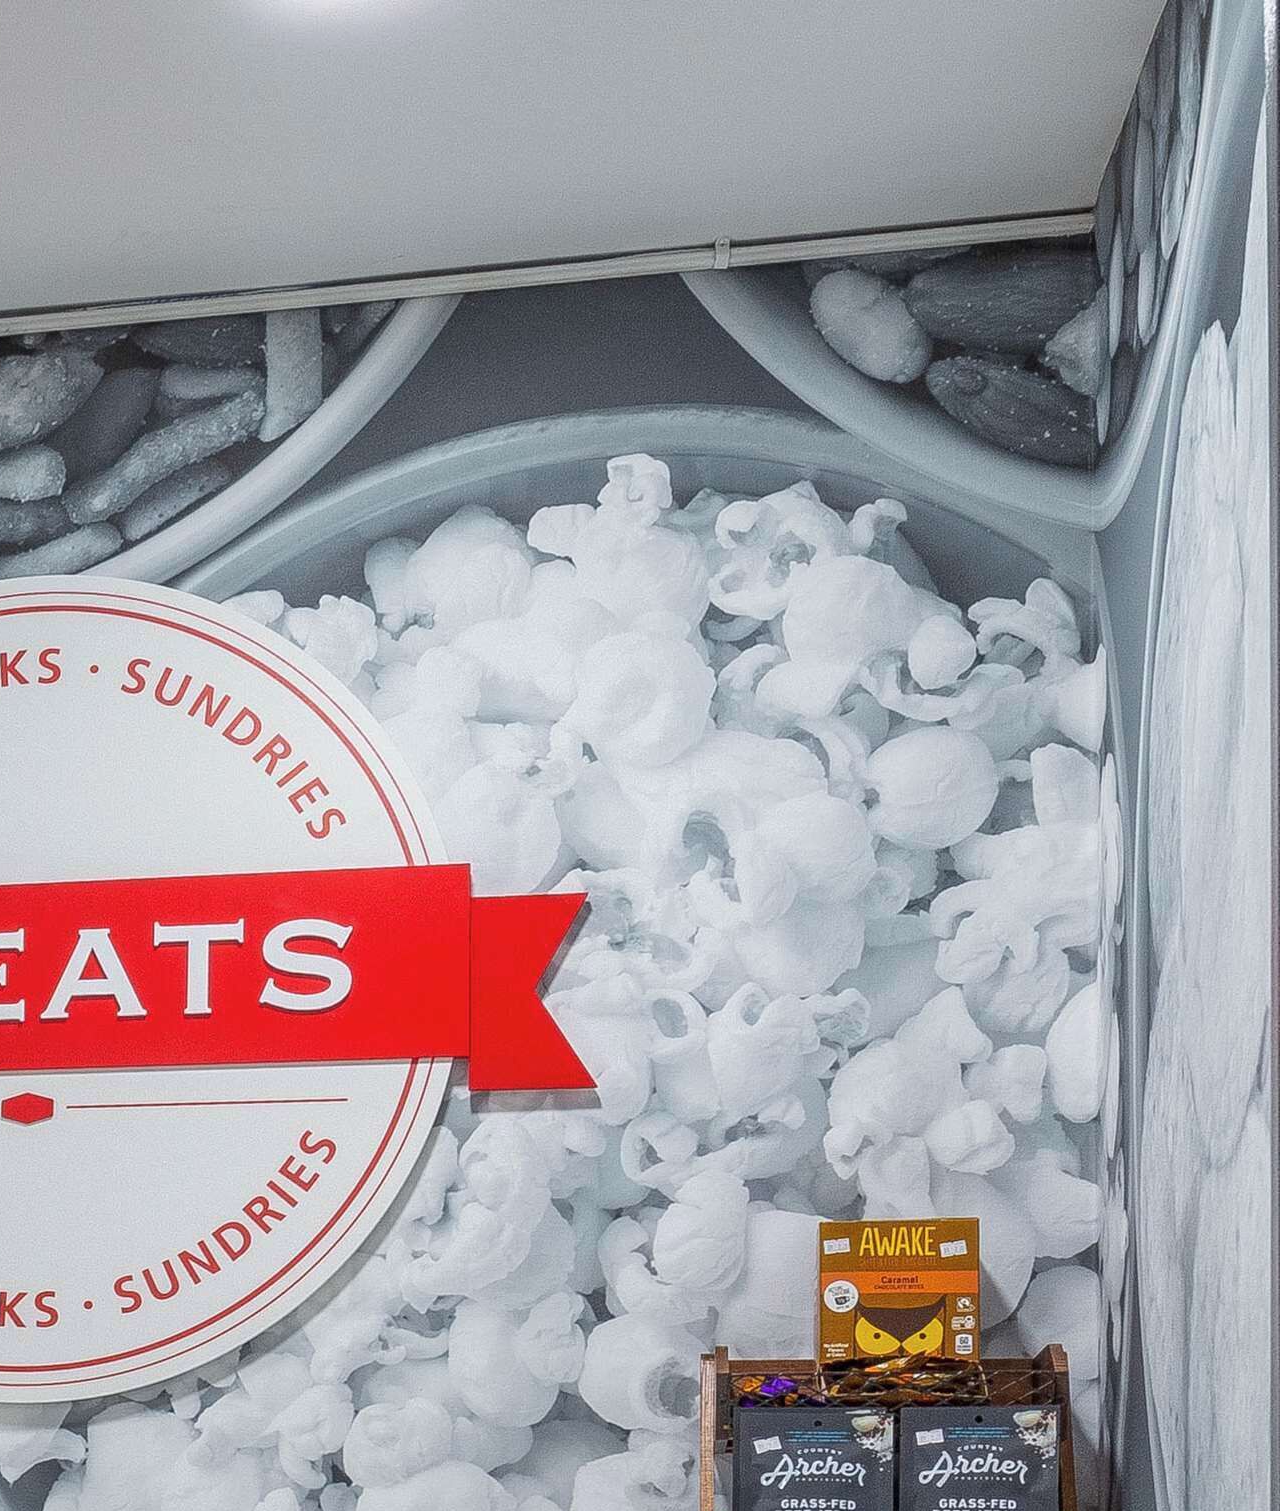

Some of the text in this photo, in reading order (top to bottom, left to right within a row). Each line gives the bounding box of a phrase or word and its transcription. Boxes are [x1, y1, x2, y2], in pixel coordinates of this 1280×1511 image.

[119, 657, 346, 839] SUNDRIES
[114, 1130, 337, 1314] SUNDRIES
[859, 1226, 937, 1257] AWAKE
[881, 1276, 919, 1284] Caramel
[797, 1447, 843, 1455] COUNTRY
[957, 1444, 1003, 1452] COUNTRY
[760, 1453, 866, 1490] Archer
[918, 1450, 1028, 1488] Archer
[780, 1498, 857, 1510] GRASS-FED
[939, 1498, 1017, 1510] GRASS-FED
